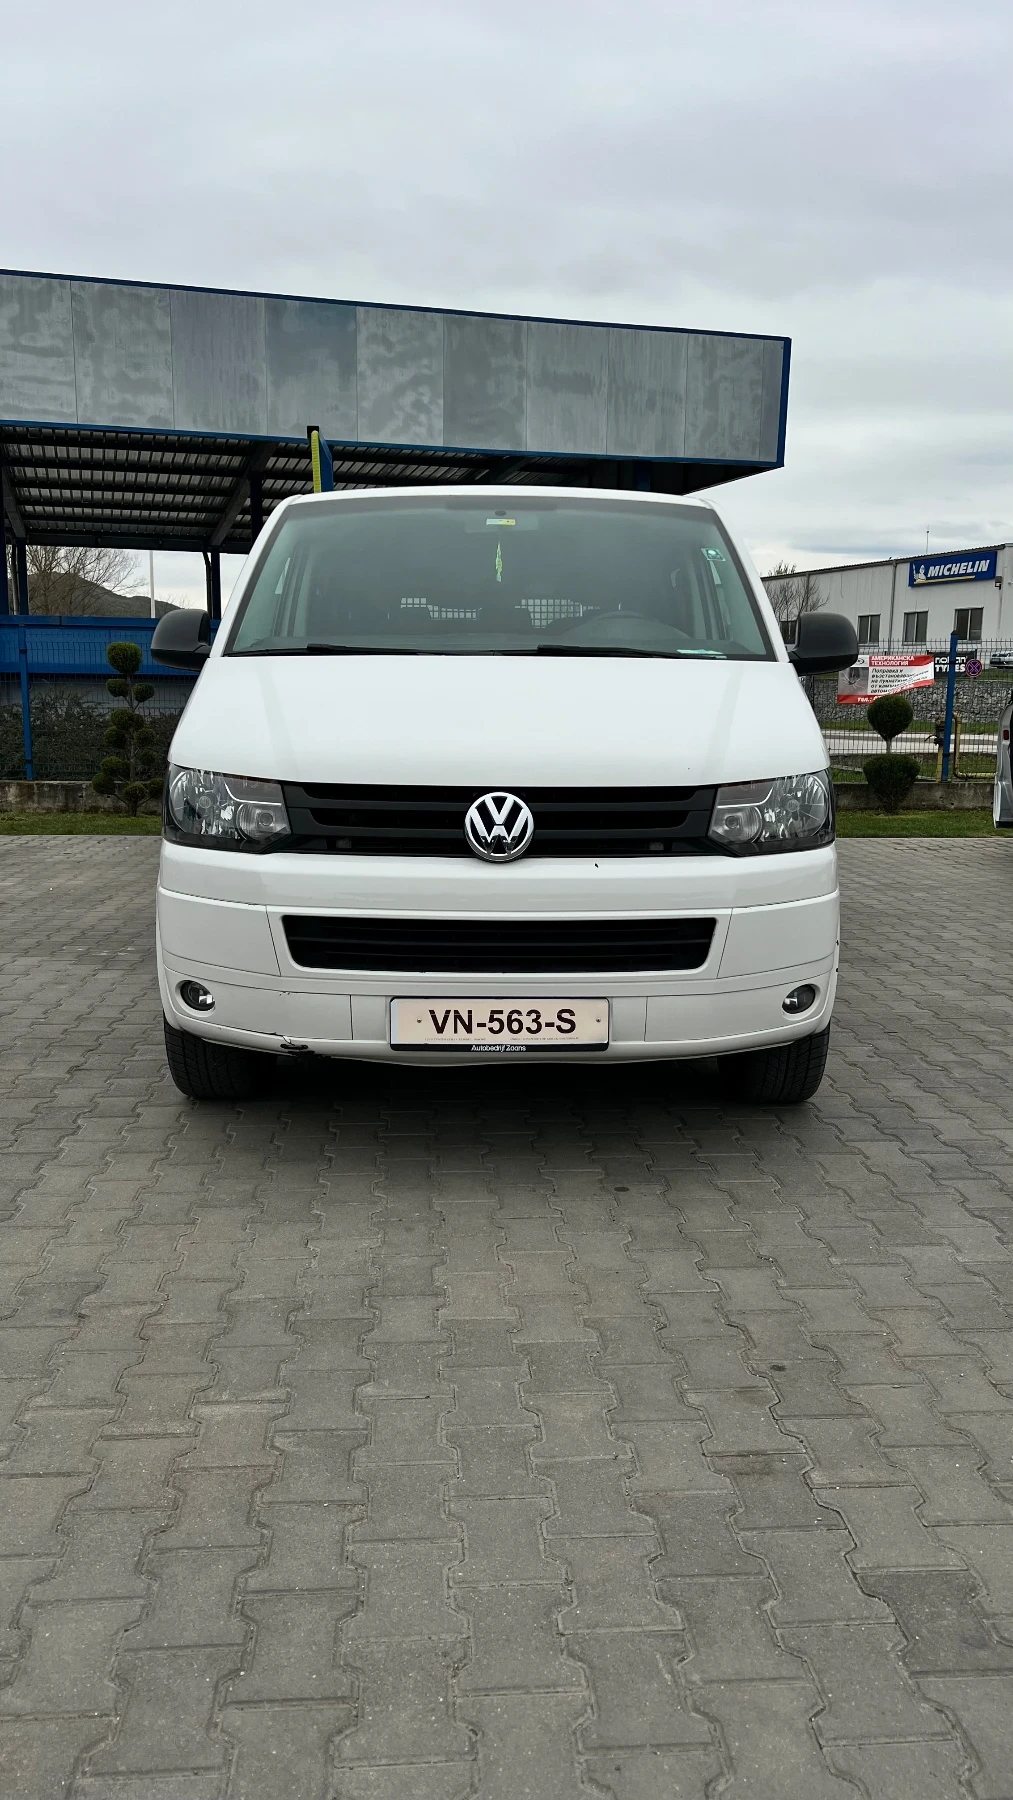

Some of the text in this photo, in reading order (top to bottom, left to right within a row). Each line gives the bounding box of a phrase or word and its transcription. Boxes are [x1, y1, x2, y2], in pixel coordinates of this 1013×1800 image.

[927, 559, 990, 577] MICHELIN
[428, 1008, 576, 1034] VN-563-S
[471, 1044, 505, 1053] Autobedrijf
